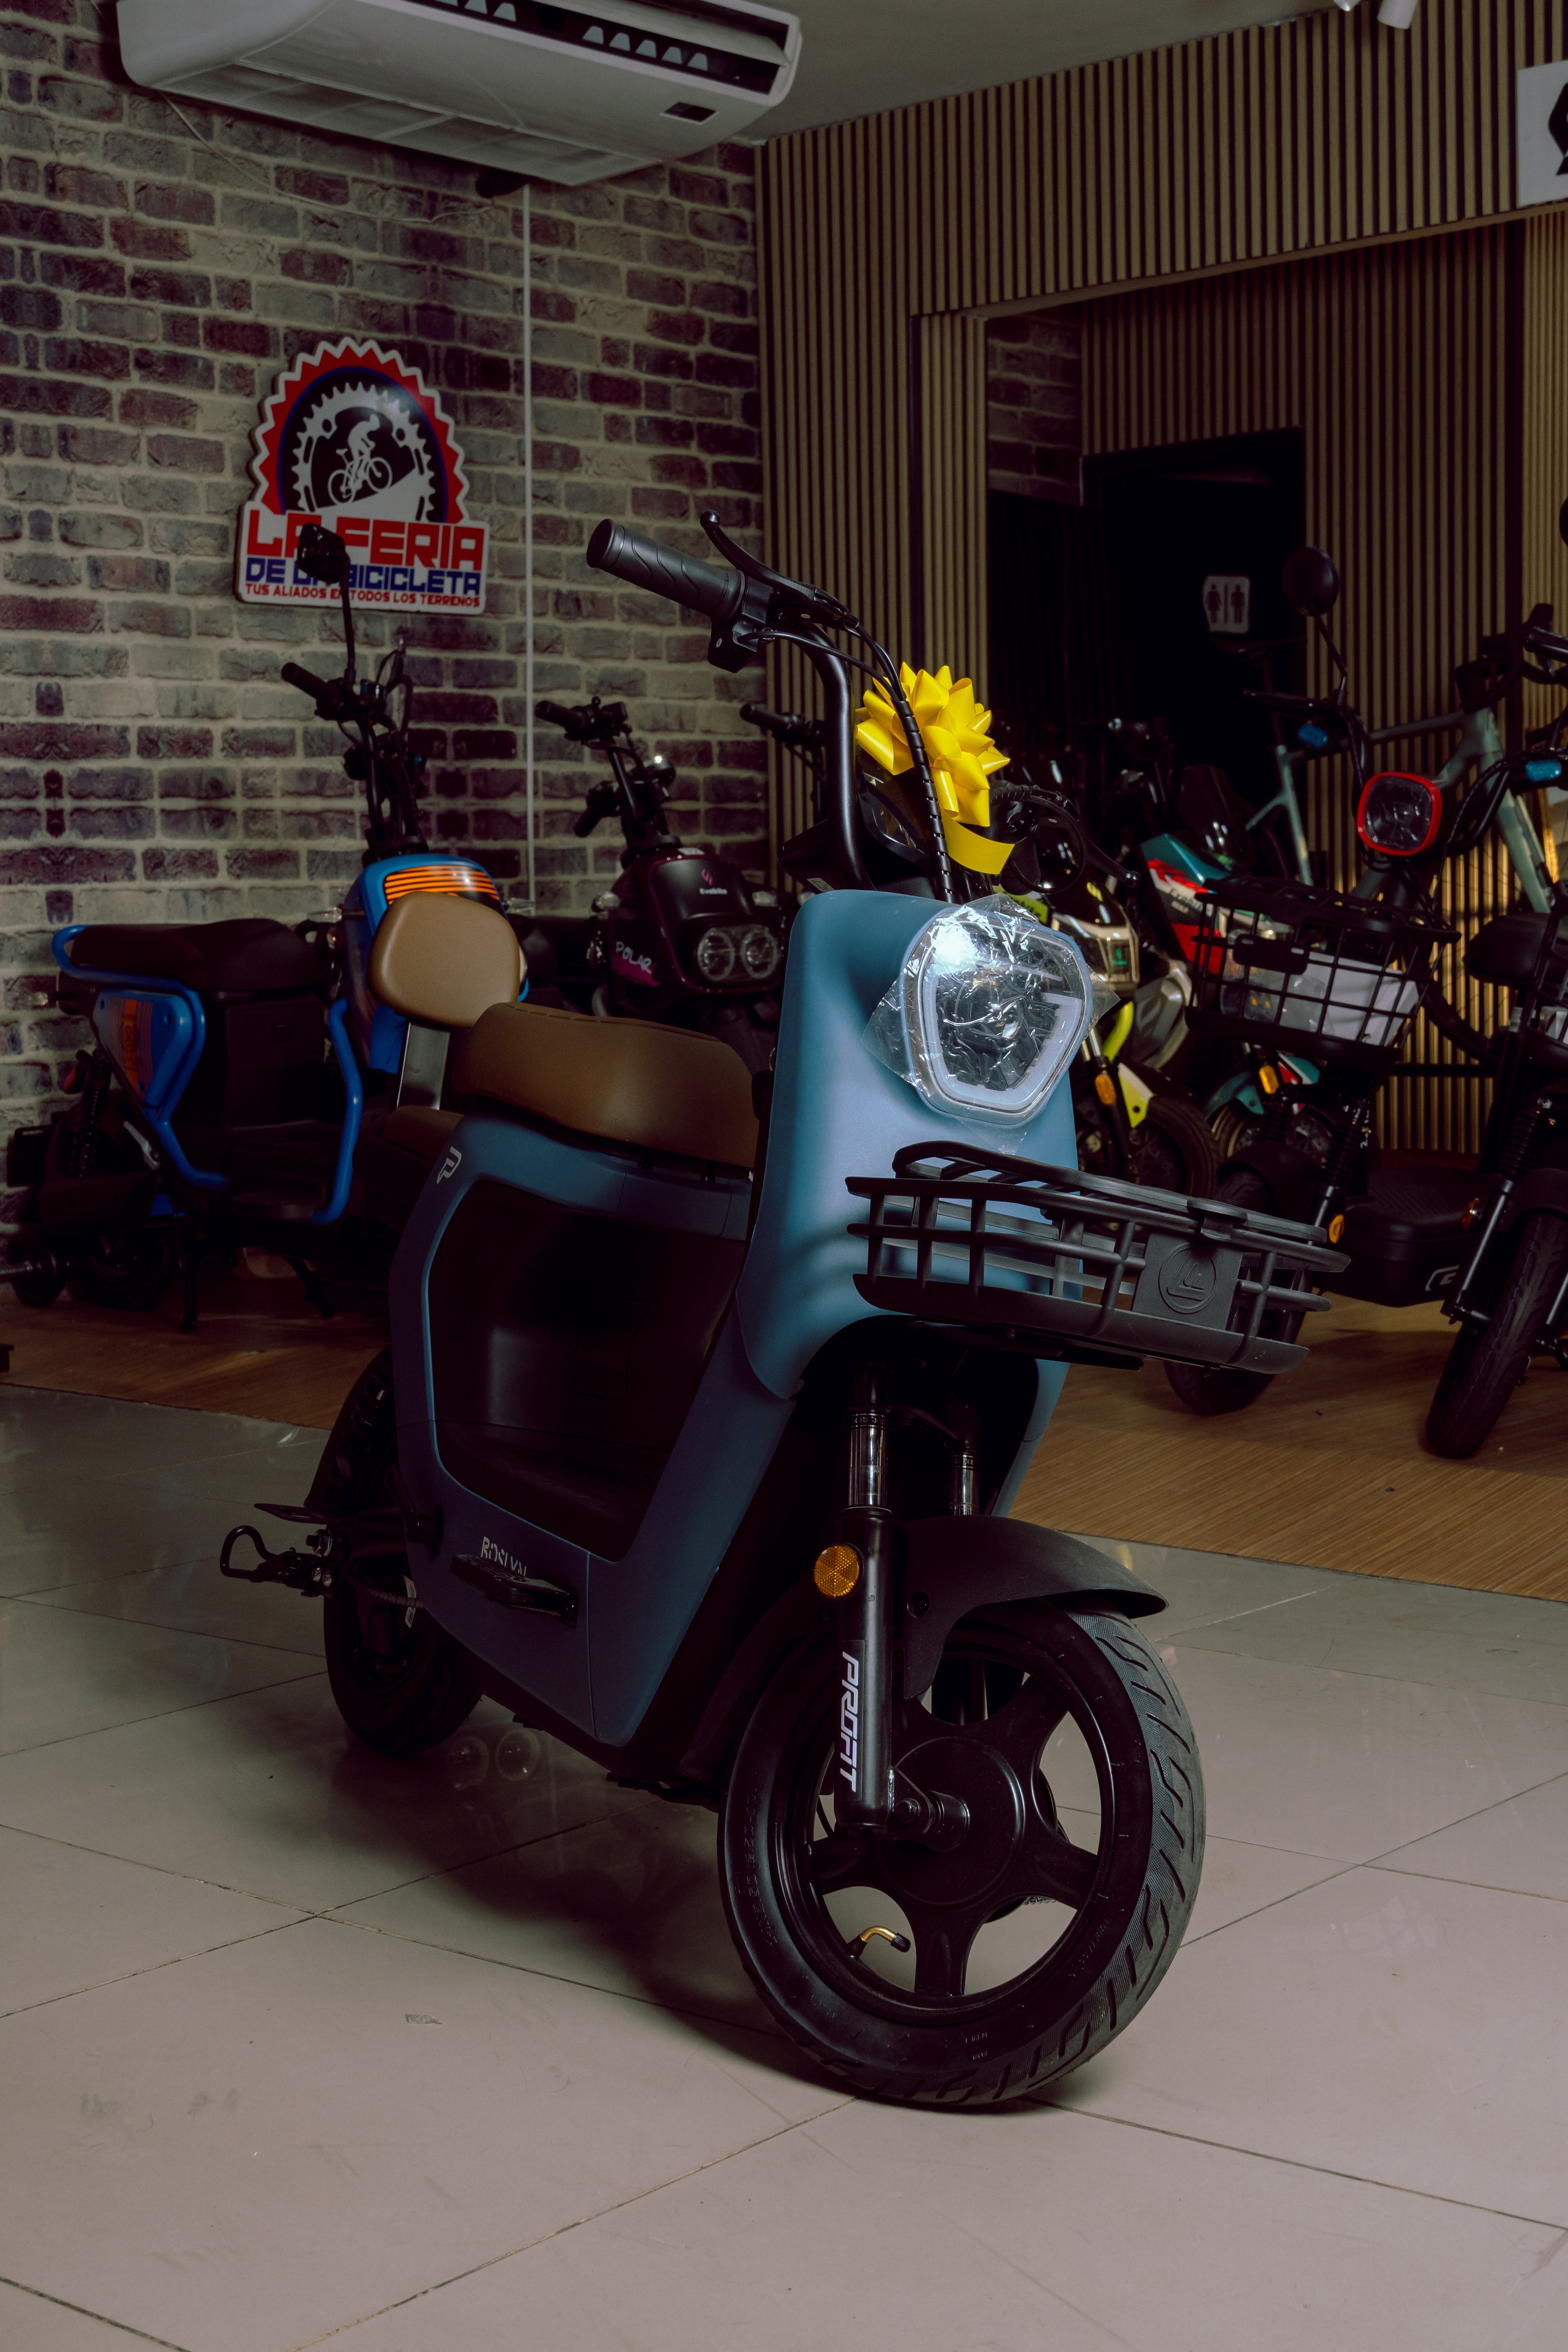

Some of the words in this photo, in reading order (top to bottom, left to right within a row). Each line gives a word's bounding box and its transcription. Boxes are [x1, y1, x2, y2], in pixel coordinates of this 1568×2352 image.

[336, 516, 485, 570] FERIA
[246, 557, 285, 584] DE
[246, 583, 269, 595] TUS
[273, 586, 327, 599] ALIADOS
[350, 590, 390, 603] TODOS
[394, 593, 416, 604] LOS
[421, 594, 480, 608] TERRENOS
[615, 941, 652, 975] POLAR
[840, 1650, 859, 1793] PROFIT
